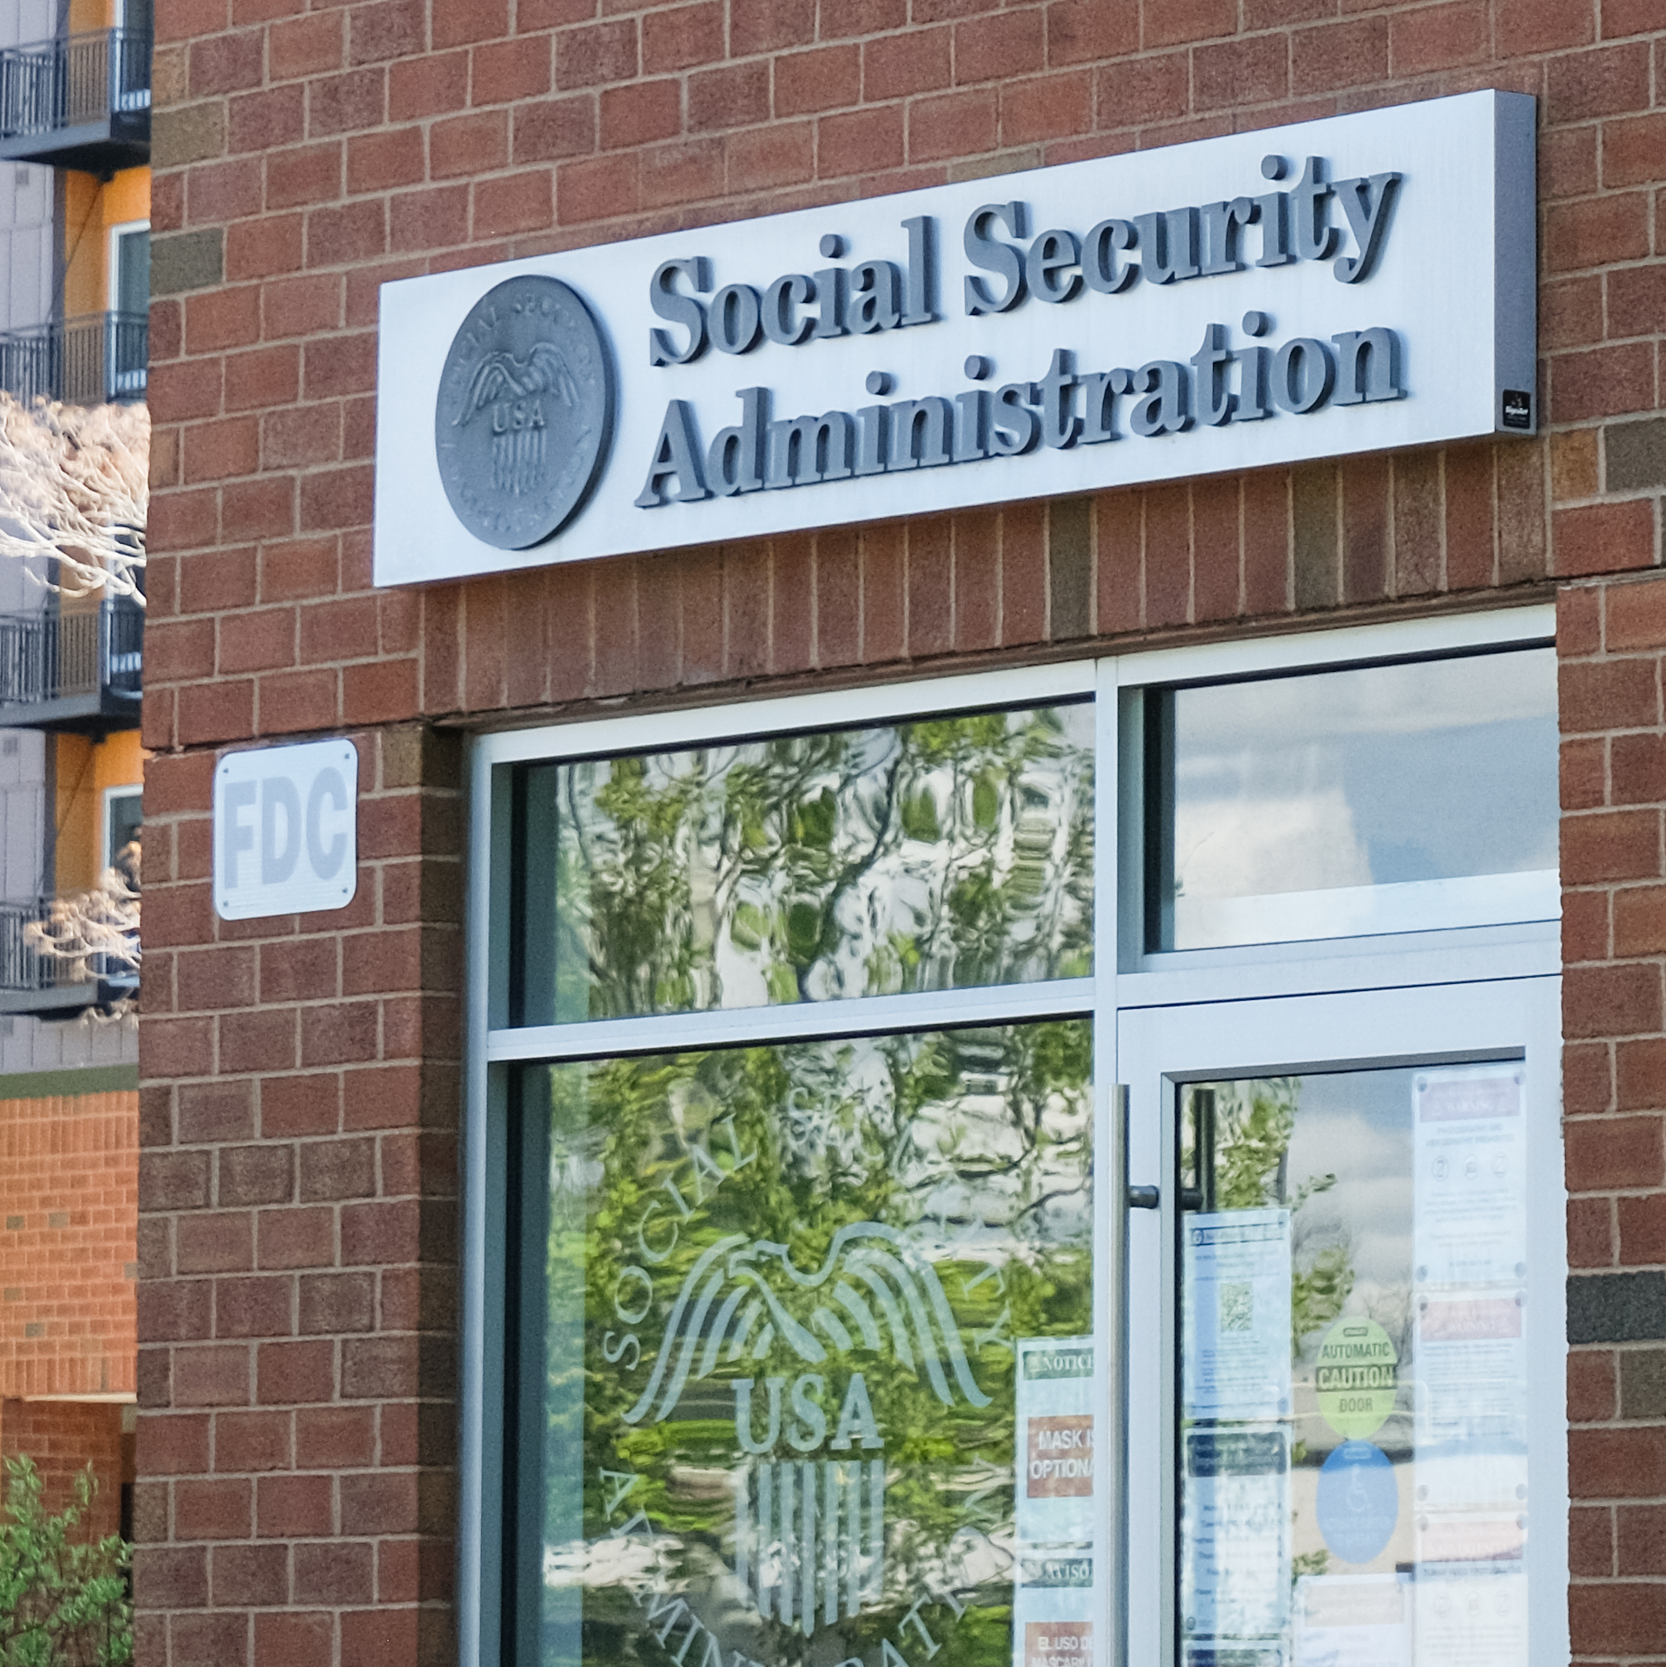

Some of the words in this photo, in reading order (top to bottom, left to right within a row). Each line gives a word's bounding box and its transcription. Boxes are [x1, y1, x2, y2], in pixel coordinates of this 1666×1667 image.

[649, 214, 940, 367] Social
[963, 155, 1404, 318] Security
[492, 397, 546, 432] USA
[635, 311, 1406, 509] Administration
[223, 766, 349, 889] FDC
[1322, 1342, 1390, 1359] AUTOMATIC
[1318, 1365, 1394, 1390] CAUTION
[731, 1372, 885, 1455] USA
[1339, 1397, 1373, 1413] DOOR
[1037, 1429, 1083, 1451] MASK
